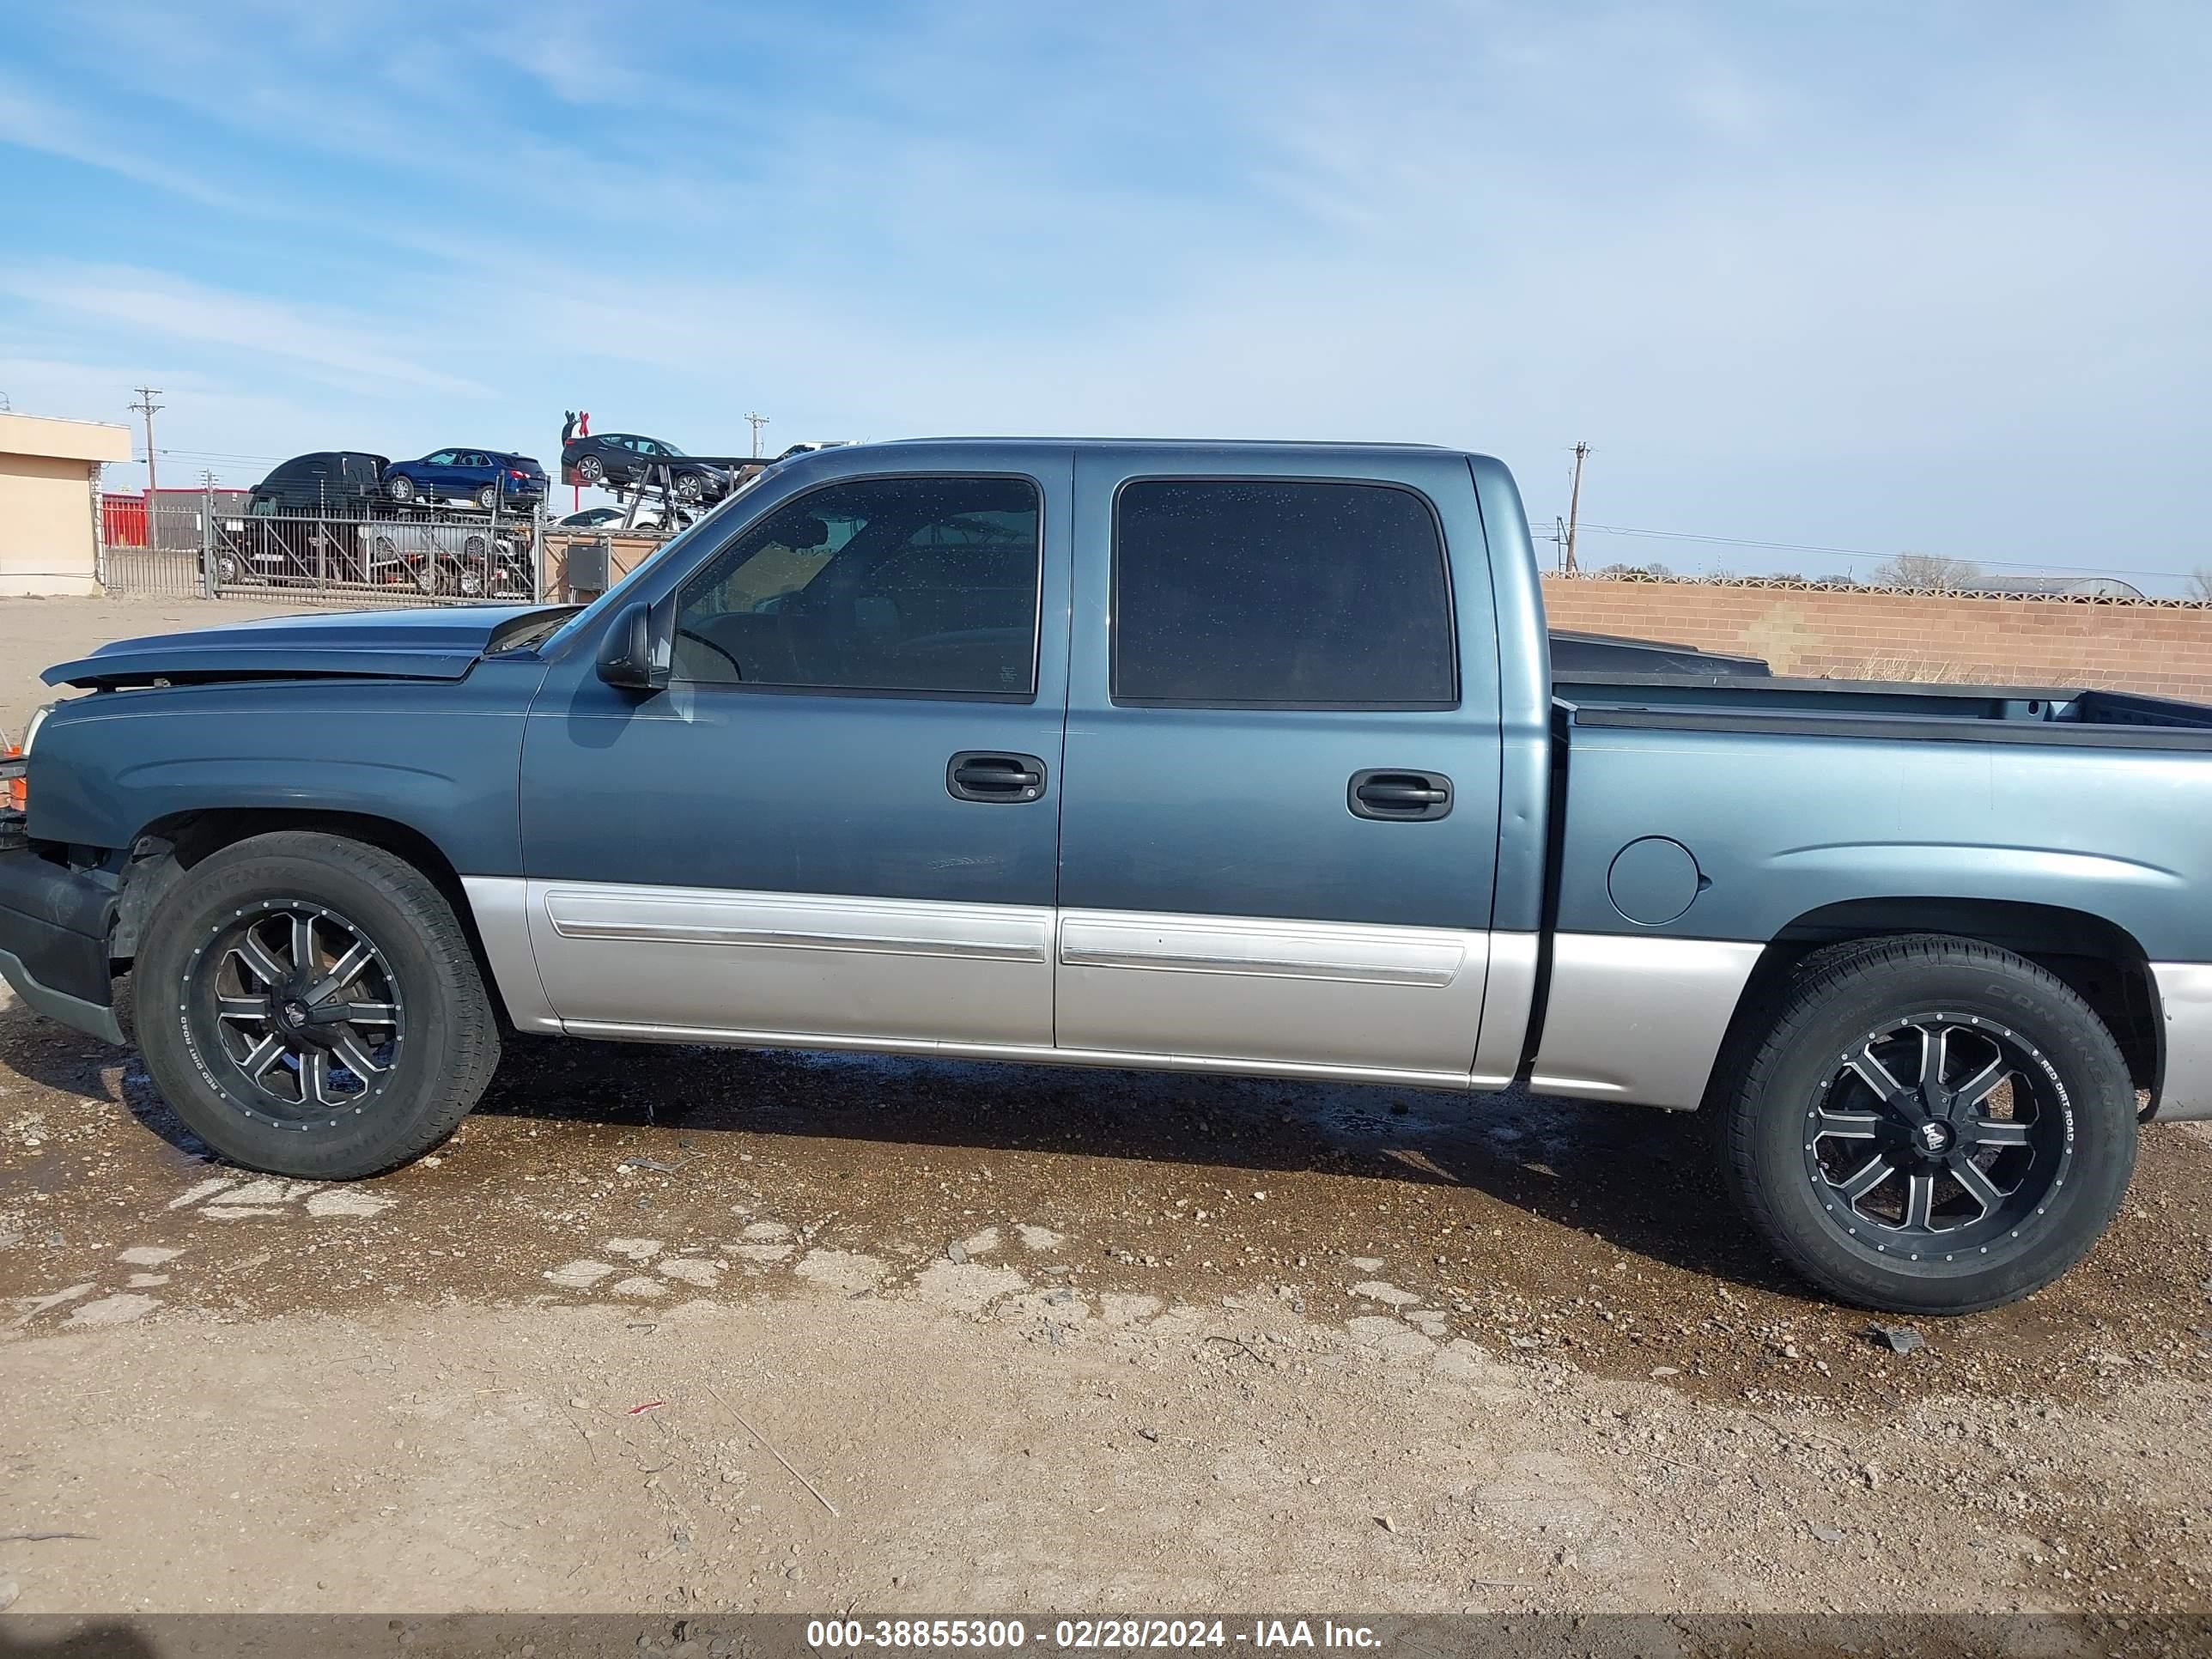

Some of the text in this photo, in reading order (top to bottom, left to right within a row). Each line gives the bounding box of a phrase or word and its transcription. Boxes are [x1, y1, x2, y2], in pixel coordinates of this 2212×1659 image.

[180, 1016, 218, 1091] RED DIRT ROAD
[2040, 1060, 2074, 1142] RED DIRT ROAD
